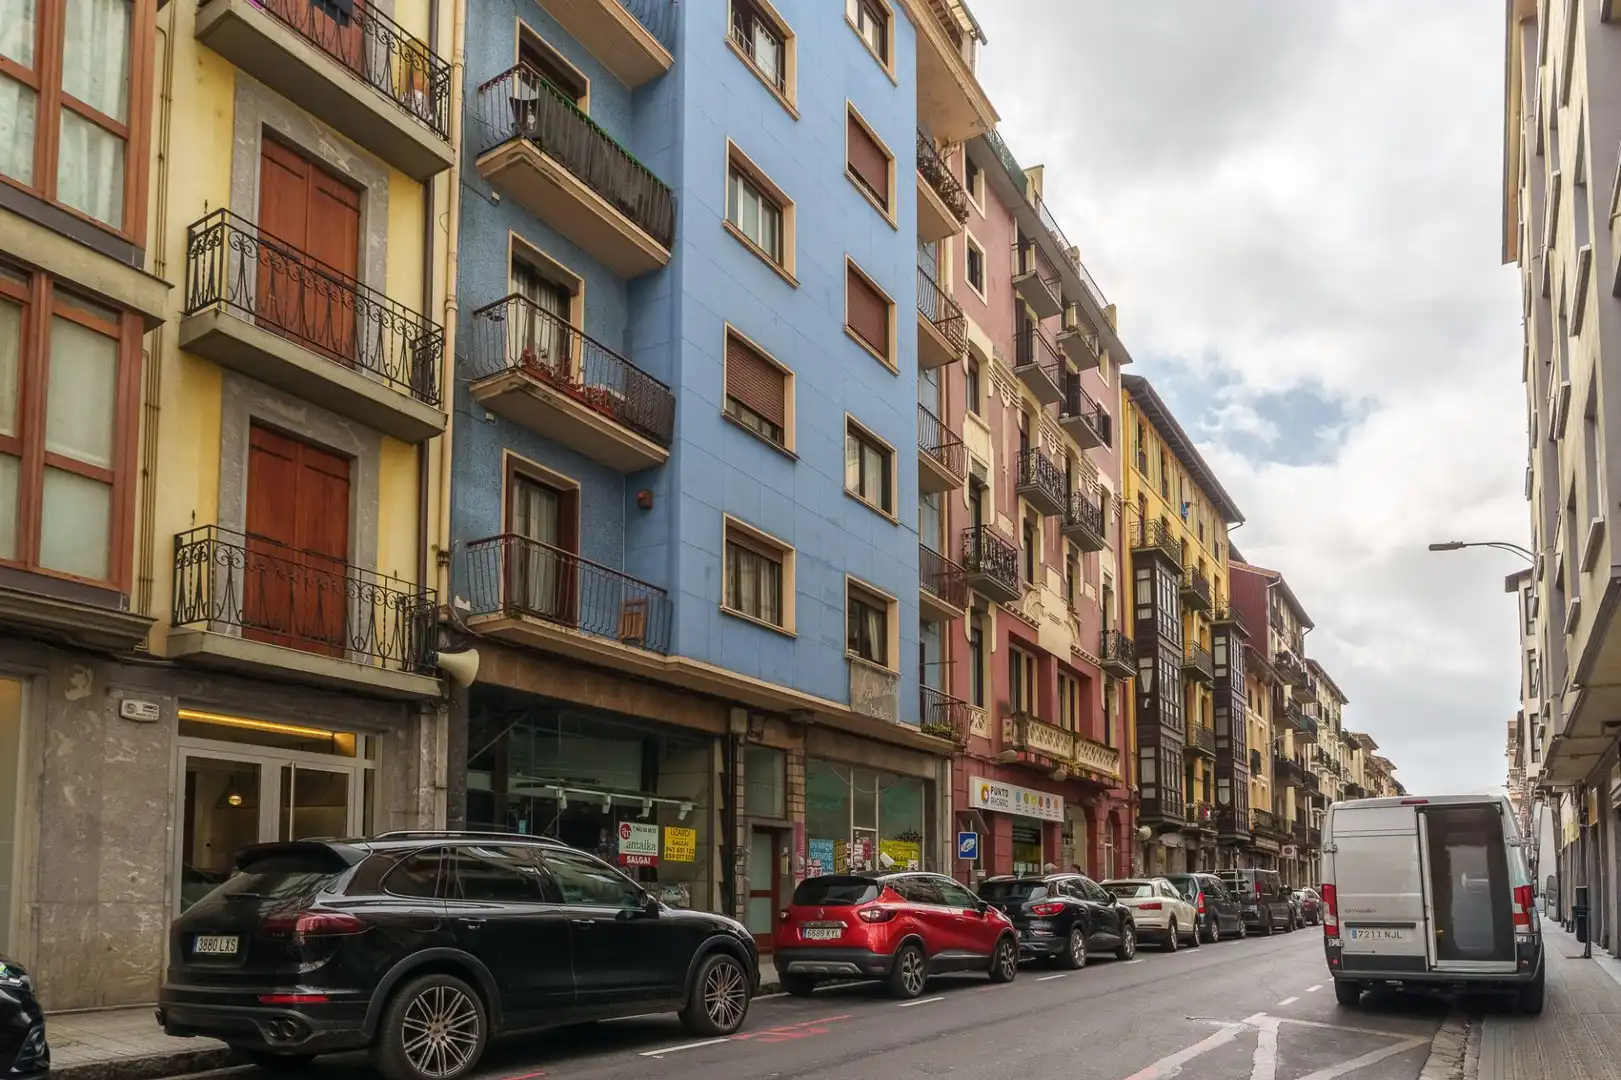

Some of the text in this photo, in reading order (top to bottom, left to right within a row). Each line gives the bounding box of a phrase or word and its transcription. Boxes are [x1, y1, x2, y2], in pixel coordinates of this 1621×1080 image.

[625, 839, 656, 851] amaika
[1358, 930, 1404, 939] 7211 NJL
[198, 937, 237, 952] 3880 LXS
